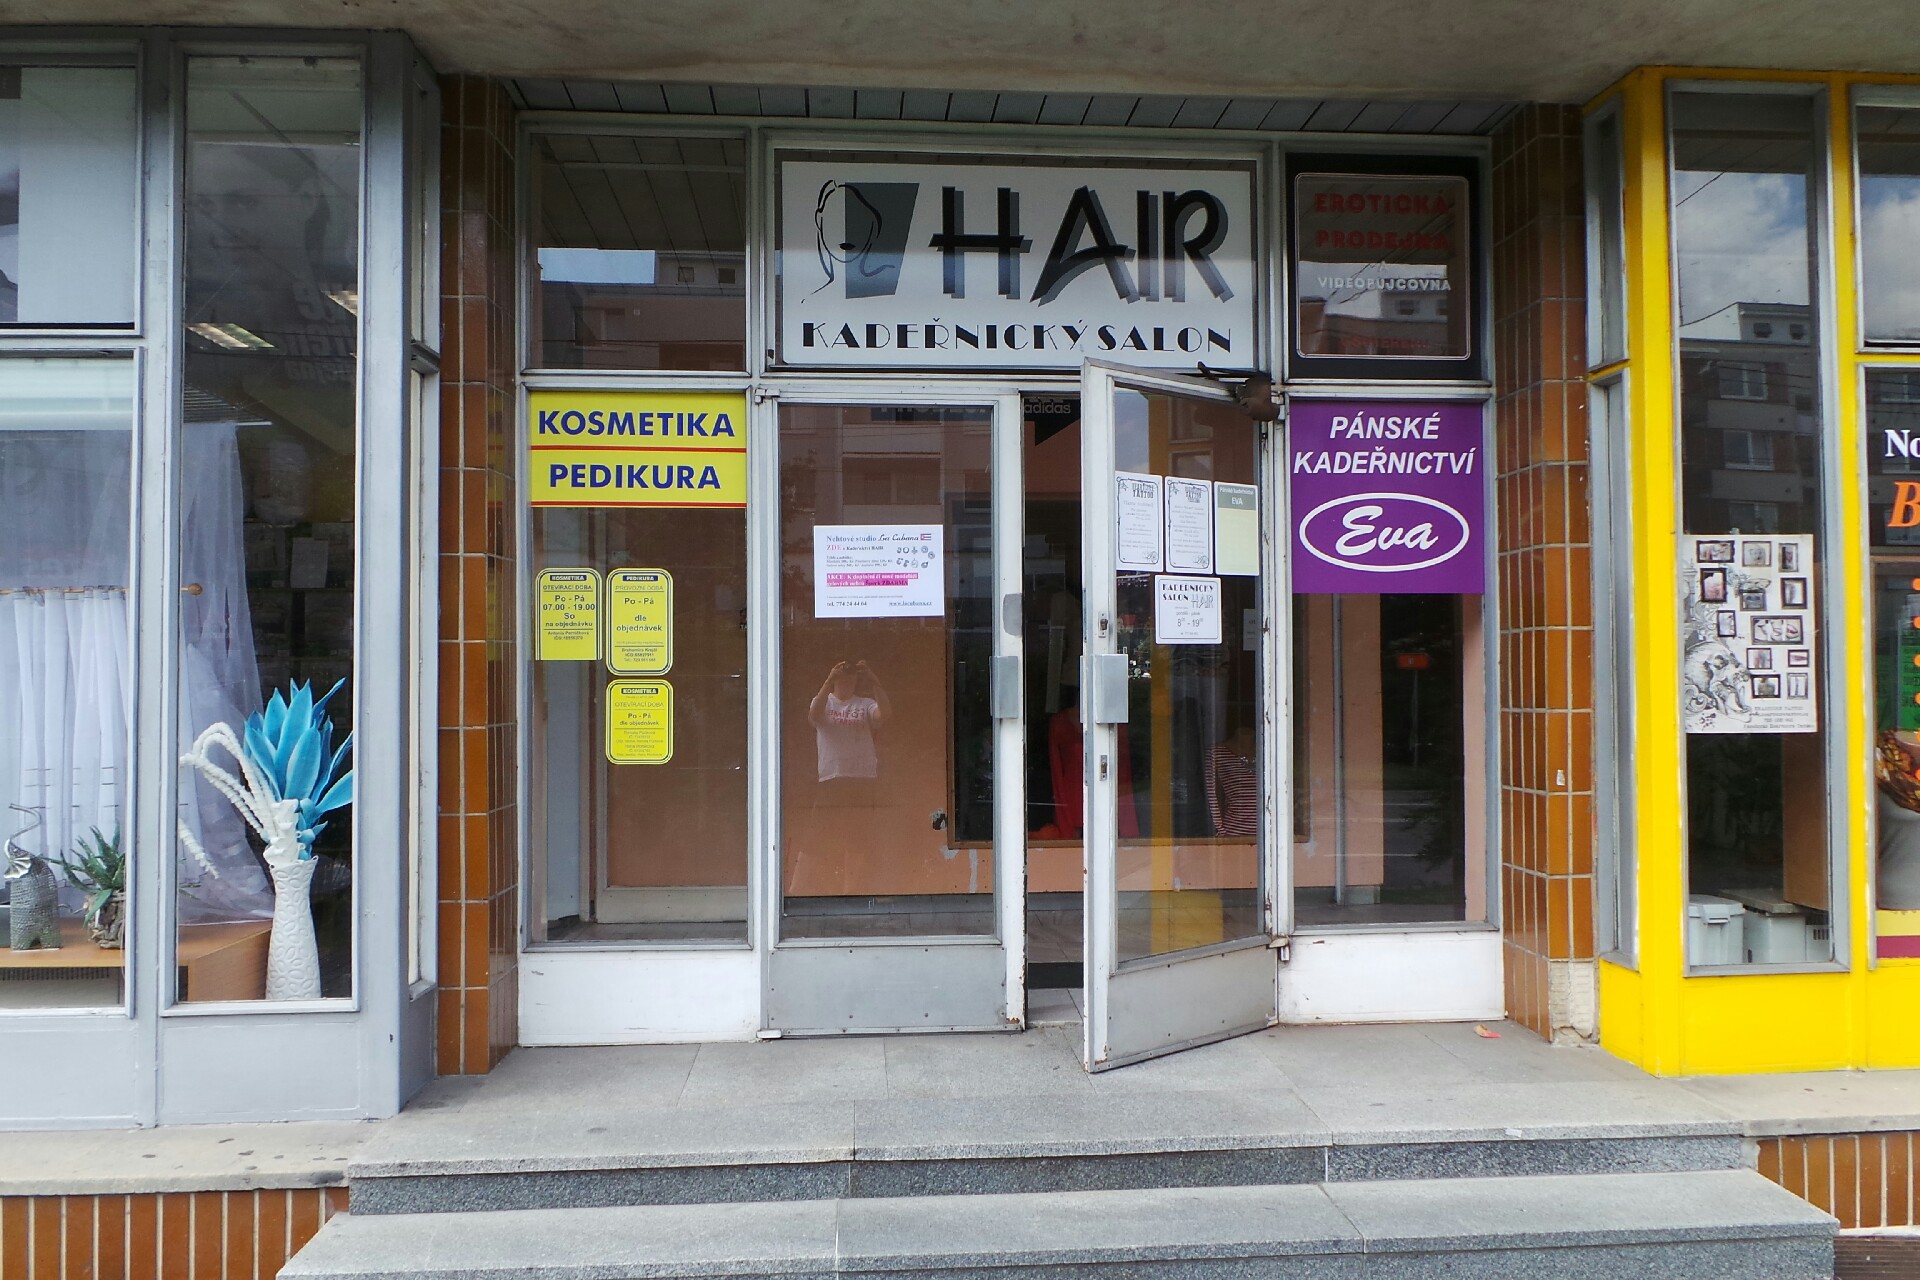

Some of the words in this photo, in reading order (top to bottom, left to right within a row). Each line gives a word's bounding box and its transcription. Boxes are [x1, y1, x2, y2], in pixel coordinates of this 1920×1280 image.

[1315, 188, 1449, 214] EROTICKÁ
[930, 185, 1234, 308] HAIR
[803, 318, 1088, 351] KADEŘNICKÝ
[1097, 324, 1231, 353] SALON
[1024, 402, 1071, 413] adidas
[538, 410, 735, 437] KOSMETIKA
[1330, 411, 1441, 440] PÁNSKÉ
[1294, 447, 1477, 475] KADEŘNICTVÍ
[549, 464, 721, 489] PEDIKURA
[1231, 497, 1243, 505] EVA
[1335, 505, 1439, 556] Eva
[574, 594, 585, 602] Pá
[624, 597, 636, 605] Po
[643, 597, 654, 605] Pá
[616, 625, 663, 633] objednávek
